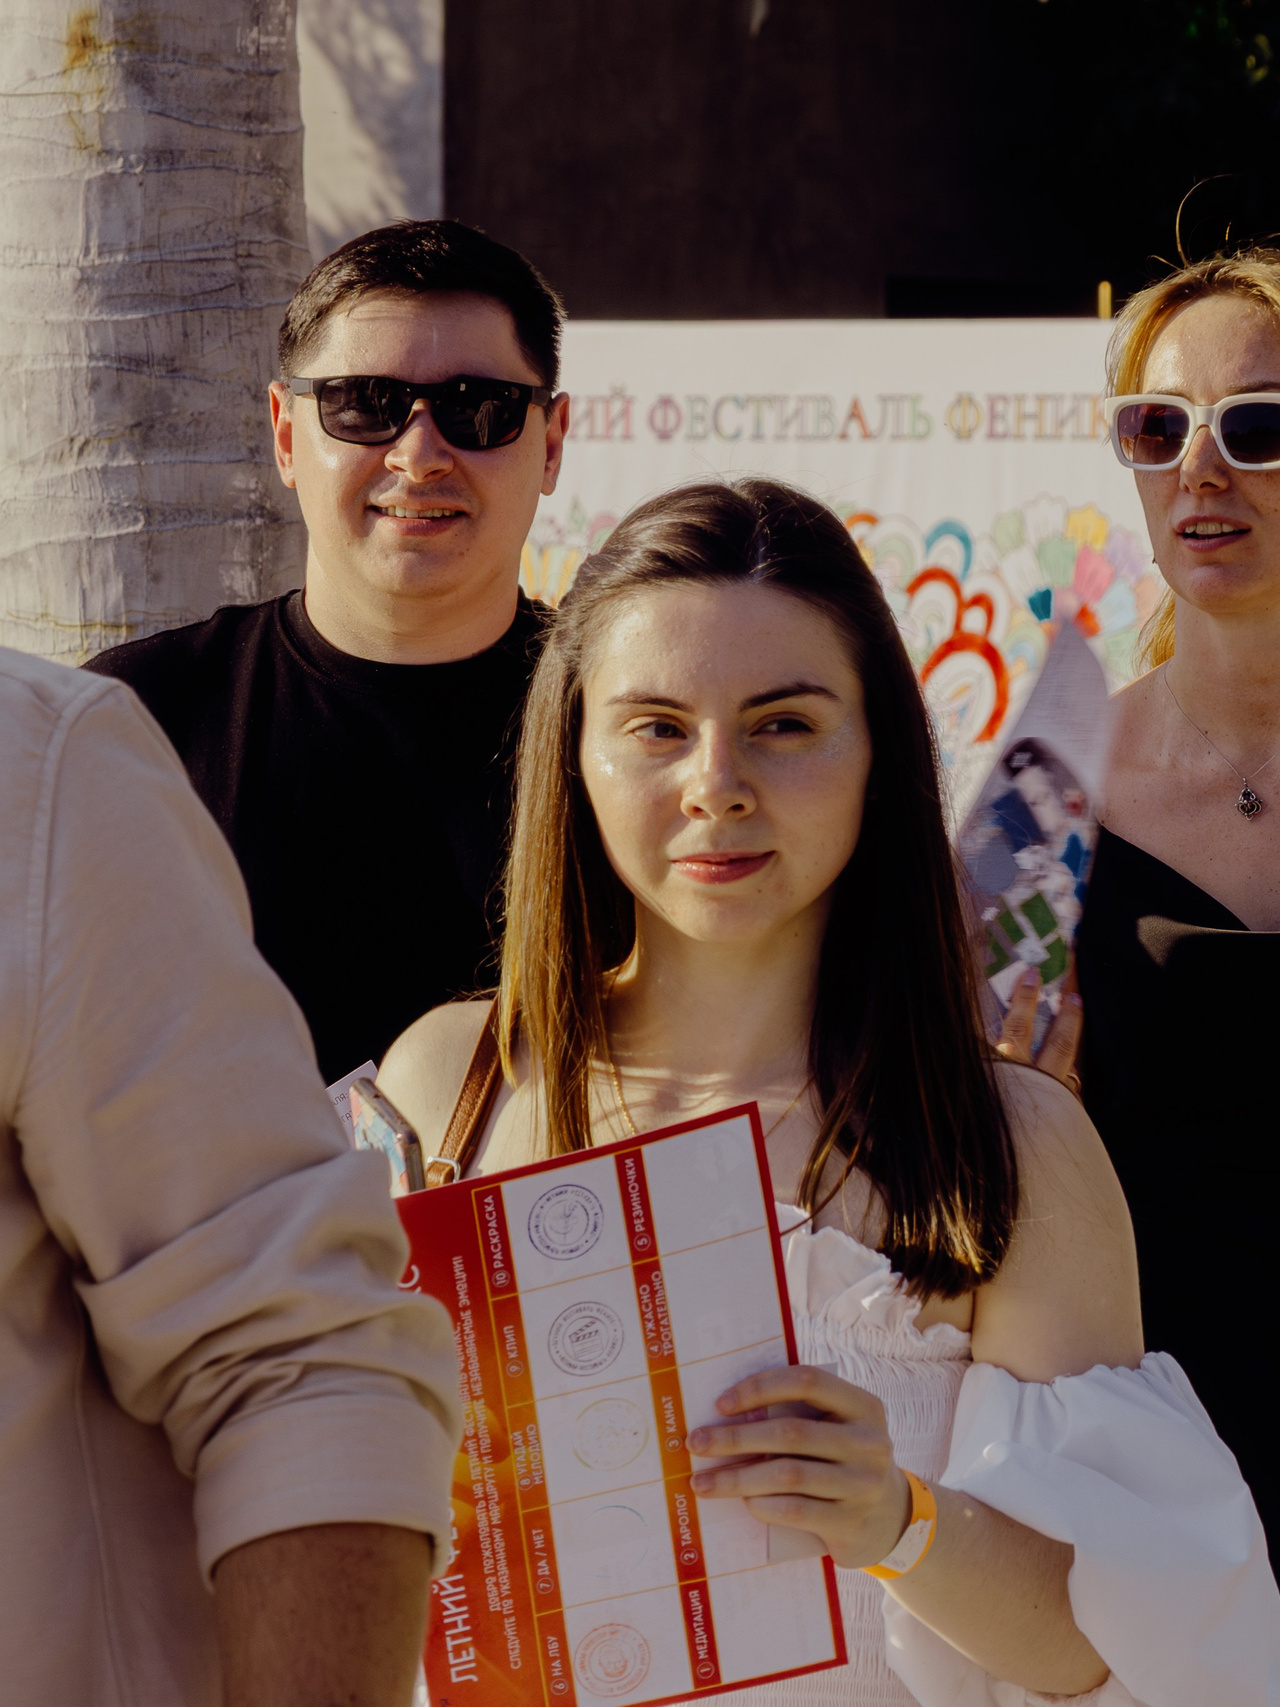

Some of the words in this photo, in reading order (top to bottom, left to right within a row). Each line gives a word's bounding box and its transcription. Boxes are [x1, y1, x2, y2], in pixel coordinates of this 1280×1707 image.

[648, 393, 933, 442] ФЕСТИВАЛЬ
[945, 392, 1109, 441] ФЕНИК
[623, 1157, 645, 1232] РЕЗИНОЧКИ
[482, 1194, 504, 1268] РАСКРАСКА
[638, 1283, 657, 1338] УЖАСНО
[650, 1269, 674, 1356] ТРОГАТЕЛЬНО
[459, 1309, 483, 1396] НЕЗАБЫВАЕМЫЕ
[502, 1324, 518, 1358] КЛИП
[455, 1371, 476, 1436] ФЕСТИВАЛЬ
[473, 1397, 492, 1453] ПОЛУЧИТЕ
[661, 1394, 677, 1433] КАНАТ
[465, 1438, 482, 1480] ЛЕТНИЙ
[509, 1430, 528, 1475] УГАДАЙ
[525, 1423, 544, 1484] МЕЛОДИЮ
[471, 1481, 485, 1498] НА
[482, 1466, 501, 1524] МАРШРУТУ
[473, 1500, 496, 1574] ПОЖАЛОВАТЬ
[531, 1527, 545, 1548] НЕТ
[674, 1491, 692, 1545] ТАРОЛОГ
[490, 1526, 512, 1596] УКАЗАННОМУ
[536, 1558, 549, 1575] ДА
[484, 1575, 501, 1611] ДОБРО
[501, 1598, 514, 1613] ПО
[432, 1573, 479, 1682] ЛЕТНИЙ
[502, 1616, 523, 1669] СЛЕДУЙТЕ
[546, 1634, 560, 1657] ЛБУ
[688, 1589, 710, 1659] МЕДИТАЦИЯ
[550, 1659, 562, 1676] НА
